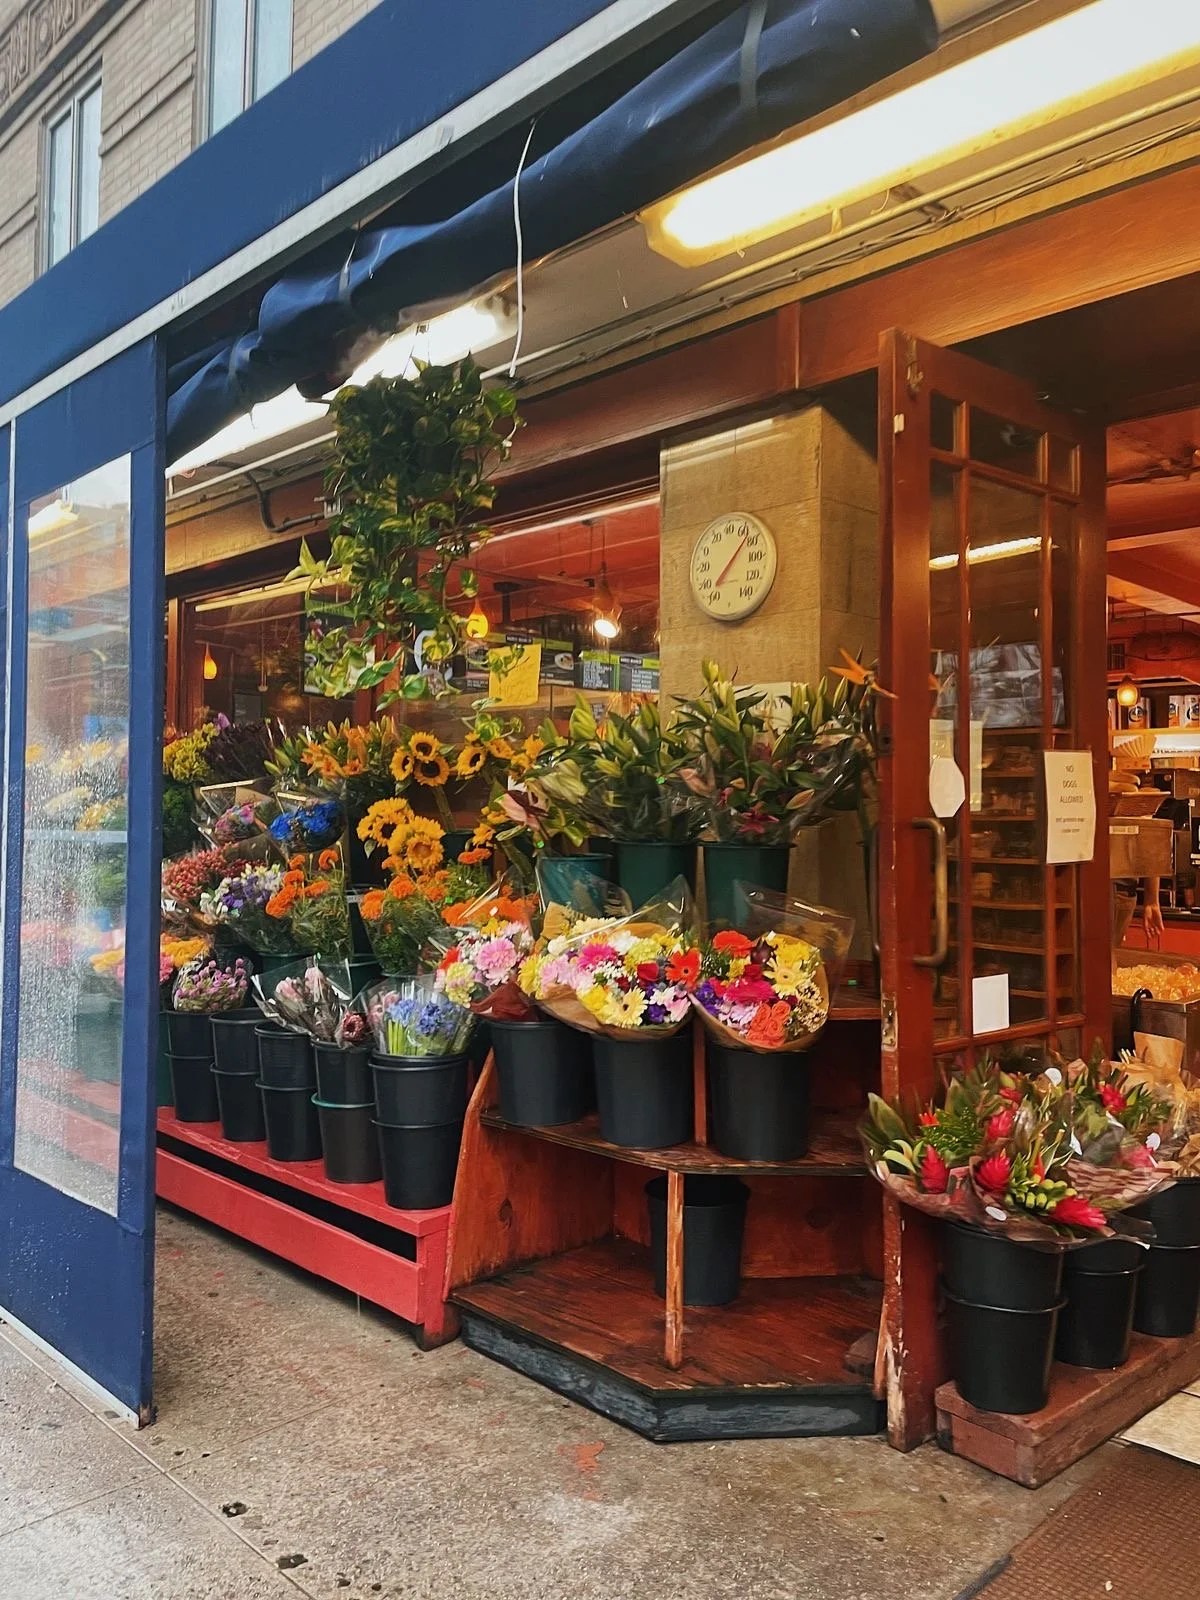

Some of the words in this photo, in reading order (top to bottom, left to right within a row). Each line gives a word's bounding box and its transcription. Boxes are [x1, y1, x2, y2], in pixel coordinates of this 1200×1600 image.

[725, 523, 734, 534] 40
[738, 524, 749, 537] 60
[711, 532, 722, 544] 20
[746, 535, 758, 546] 80
[703, 547, 710, 556] 0
[748, 553, 762, 563] 100
[746, 569, 760, 581] 120
[739, 586, 753, 598] 140
[1065, 765, 1074, 773] NO
[1062, 780, 1078, 788] DOGS
[1059, 795, 1084, 804] ALLOWED
